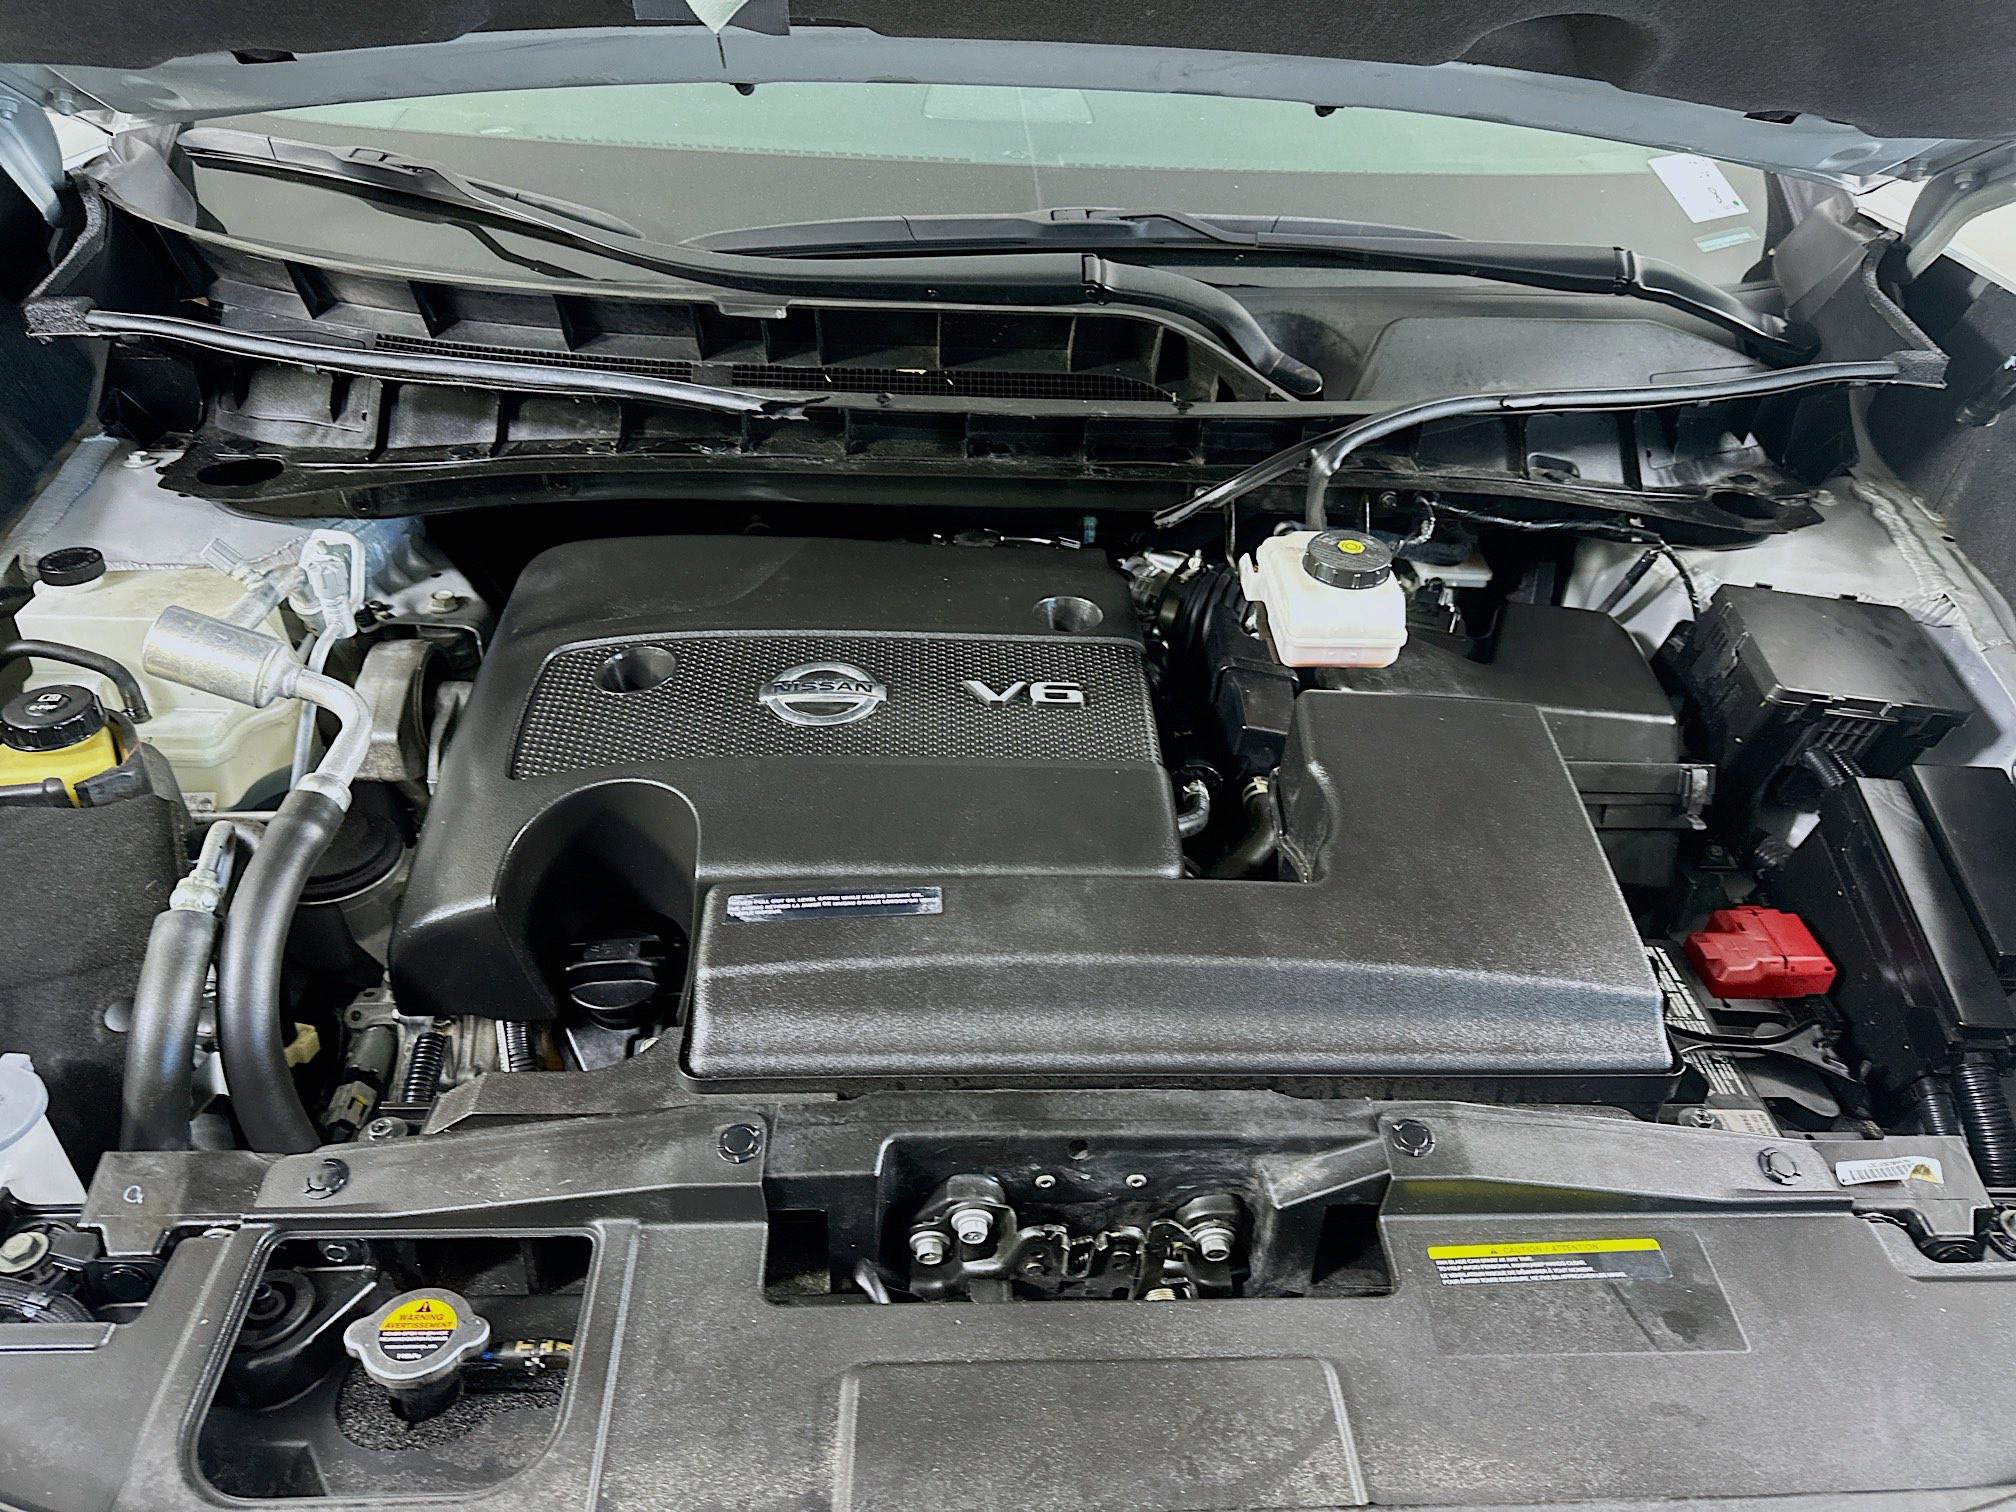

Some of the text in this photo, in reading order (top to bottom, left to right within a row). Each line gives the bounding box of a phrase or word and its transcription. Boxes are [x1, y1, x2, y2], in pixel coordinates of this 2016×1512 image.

[773, 680, 873, 693] NISSAN
[963, 680, 1086, 706] V6
[1551, 1243, 1600, 1251] ATTENTION
[399, 1313, 445, 1321] WARNING
